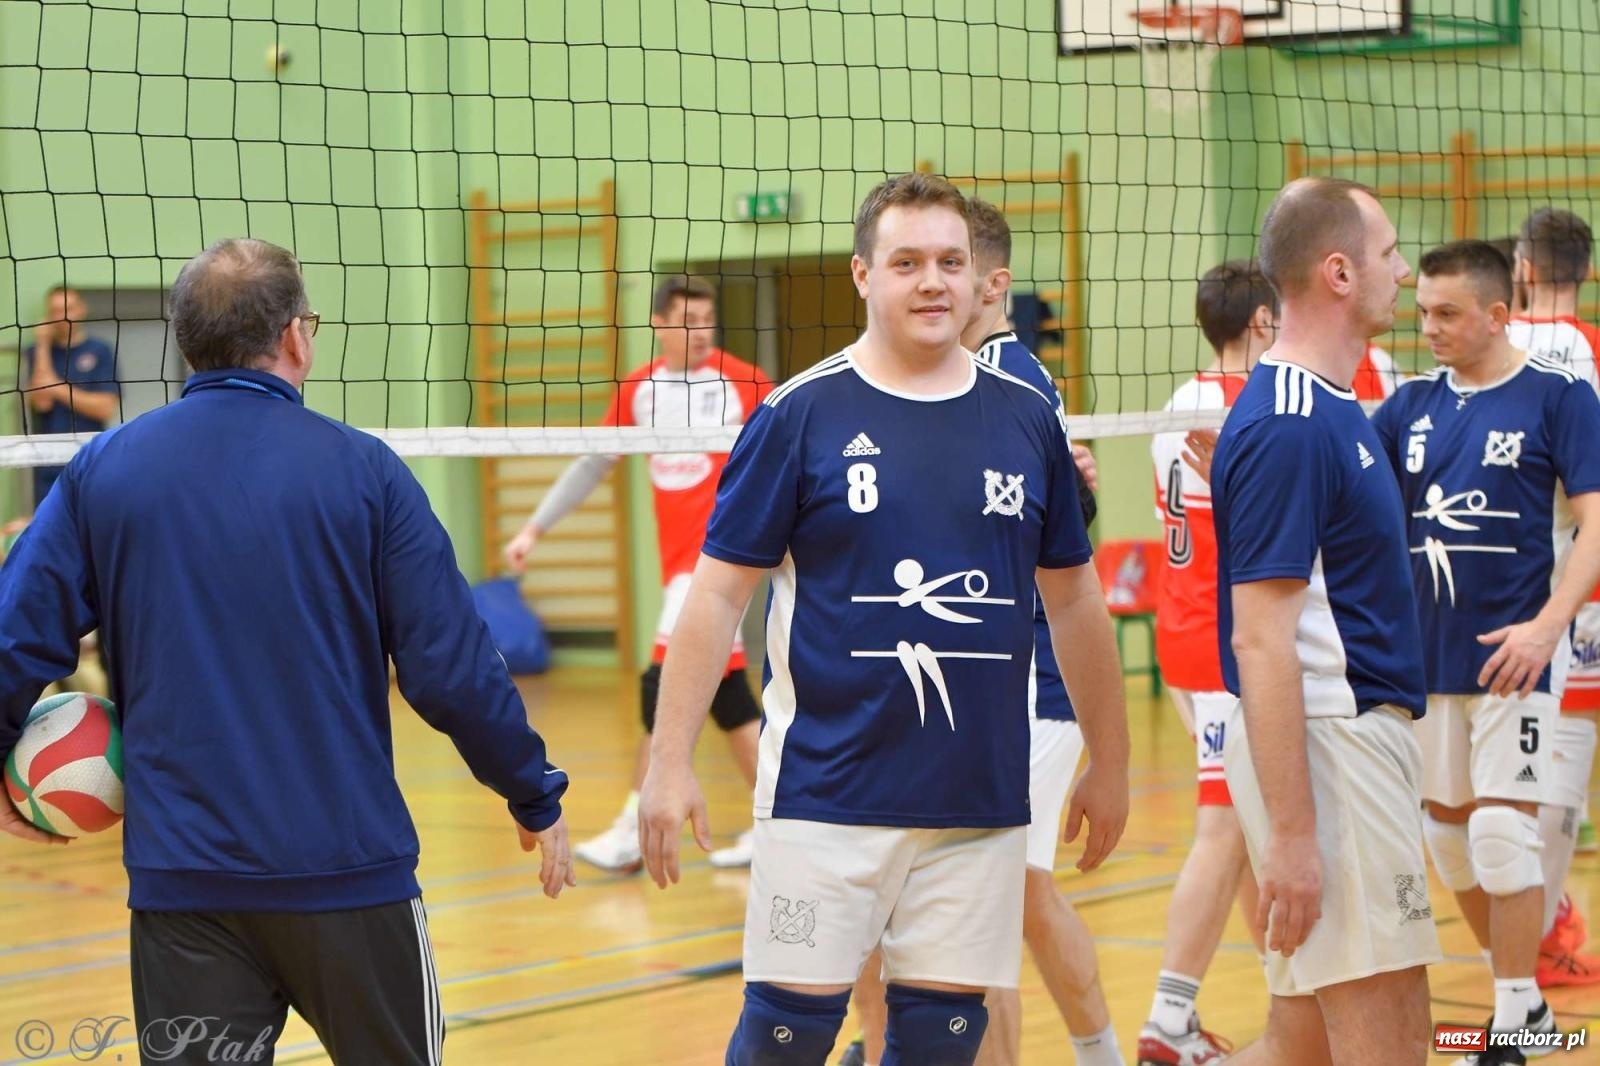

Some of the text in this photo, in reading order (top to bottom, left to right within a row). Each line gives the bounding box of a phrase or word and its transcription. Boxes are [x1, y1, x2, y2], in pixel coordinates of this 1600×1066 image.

[843, 447, 881, 457] adidas
[1406, 434, 1426, 473] 5
[847, 463, 878, 513] 8
[1520, 716, 1539, 754] 5
